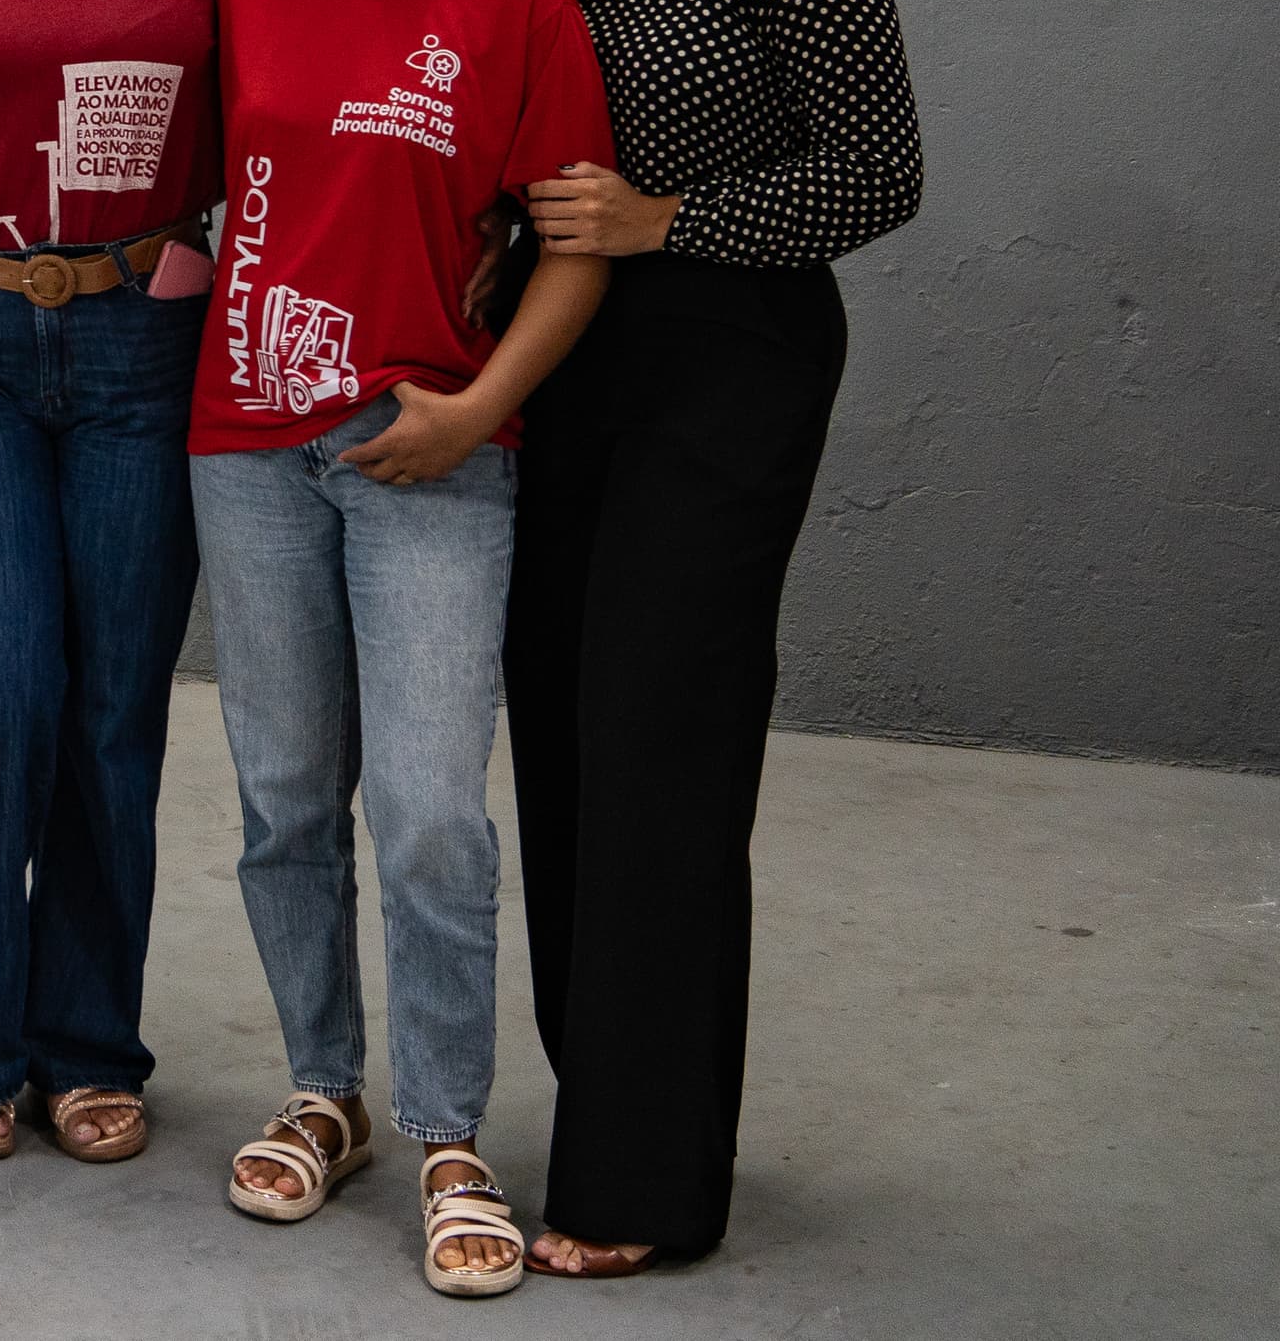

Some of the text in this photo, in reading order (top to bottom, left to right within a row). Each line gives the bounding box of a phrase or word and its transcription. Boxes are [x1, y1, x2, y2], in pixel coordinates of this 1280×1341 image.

[75, 75, 173, 93] ELEVAMOS
[77, 90, 169, 111] AO MÁXIMO
[77, 112, 167, 128] A QUALIDADE
[339, 101, 455, 136] parceiros na
[77, 128, 165, 141] E A PRODUTIVIDADE
[331, 117, 457, 157] produtividade
[77, 141, 161, 157] NOS NOSSOS
[76, 157, 158, 178] CLIENTES
[227, 155, 273, 387] MULTYLOG
